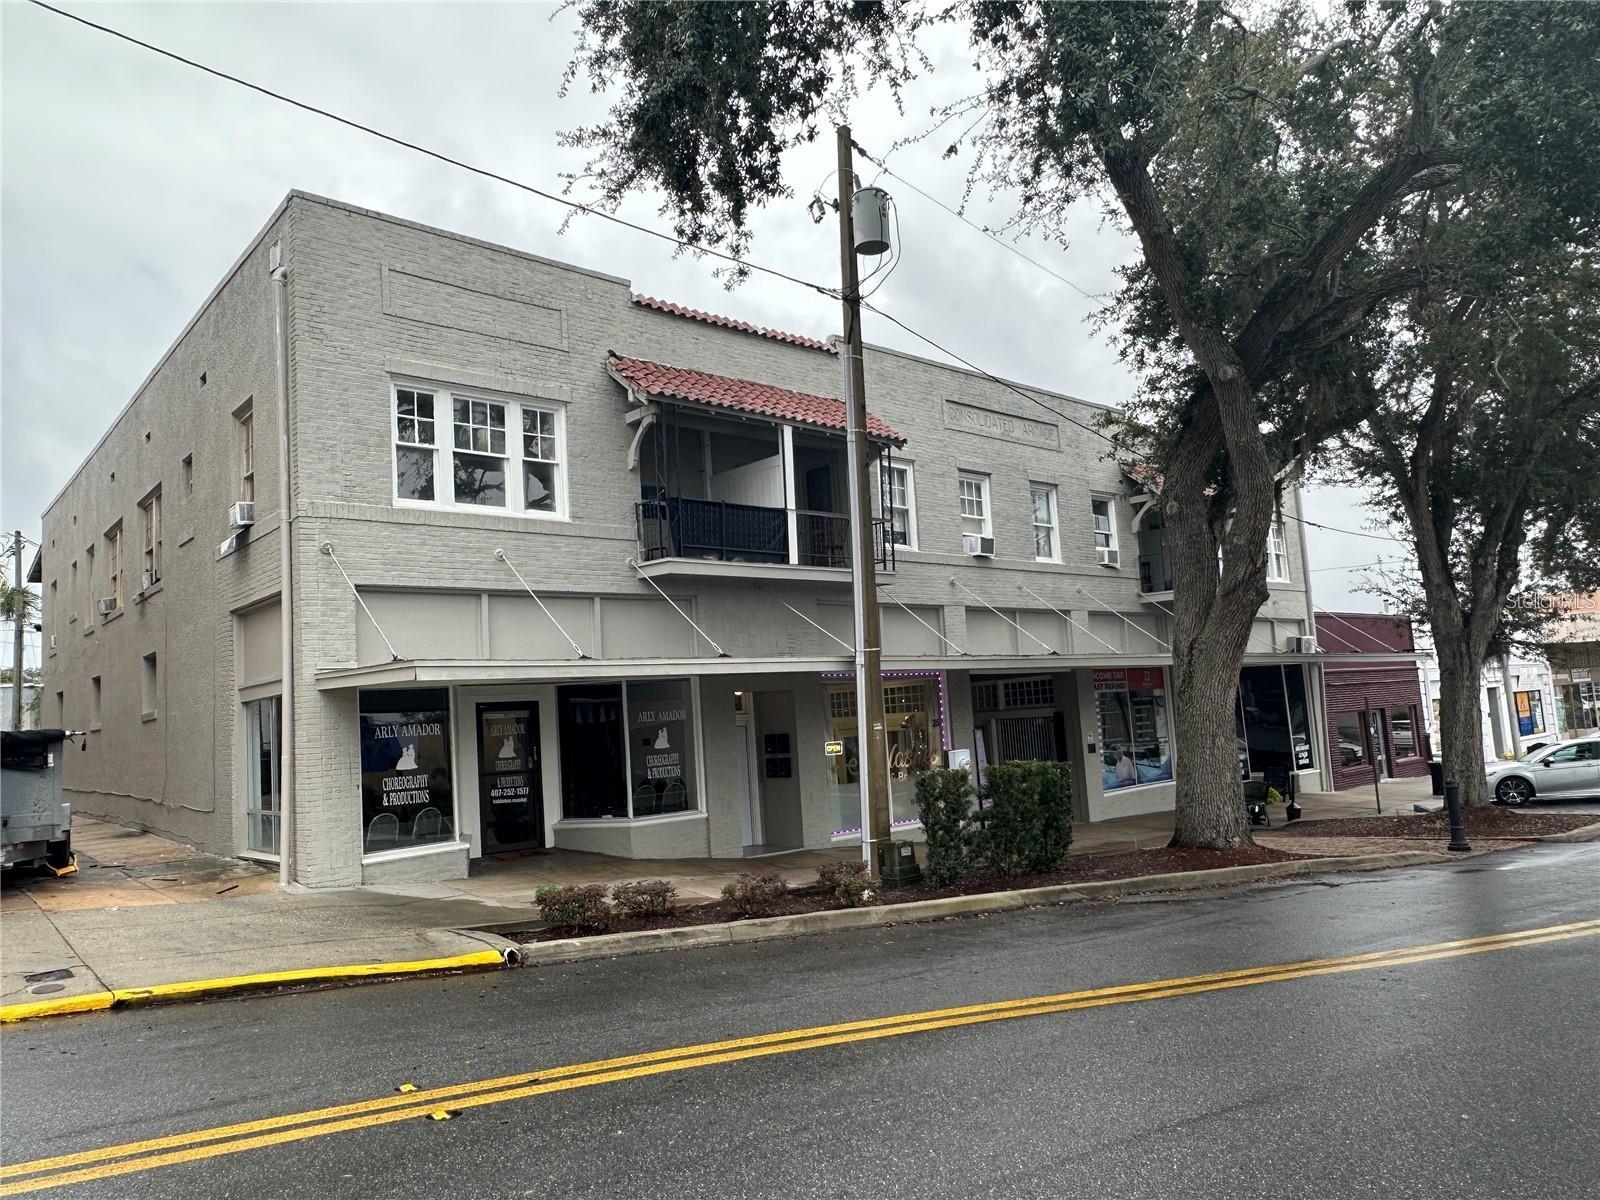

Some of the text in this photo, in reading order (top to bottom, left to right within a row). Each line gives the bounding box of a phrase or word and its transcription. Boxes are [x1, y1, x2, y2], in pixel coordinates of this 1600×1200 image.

[638, 709, 687, 723] ARLY AMADOR
[374, 723, 441, 740] ARLY AMADOR
[827, 744, 840, 752] OPEN
[382, 773, 429, 791] CHOREOGRAPHY
[382, 789, 430, 807] & PRODUCTIONS
